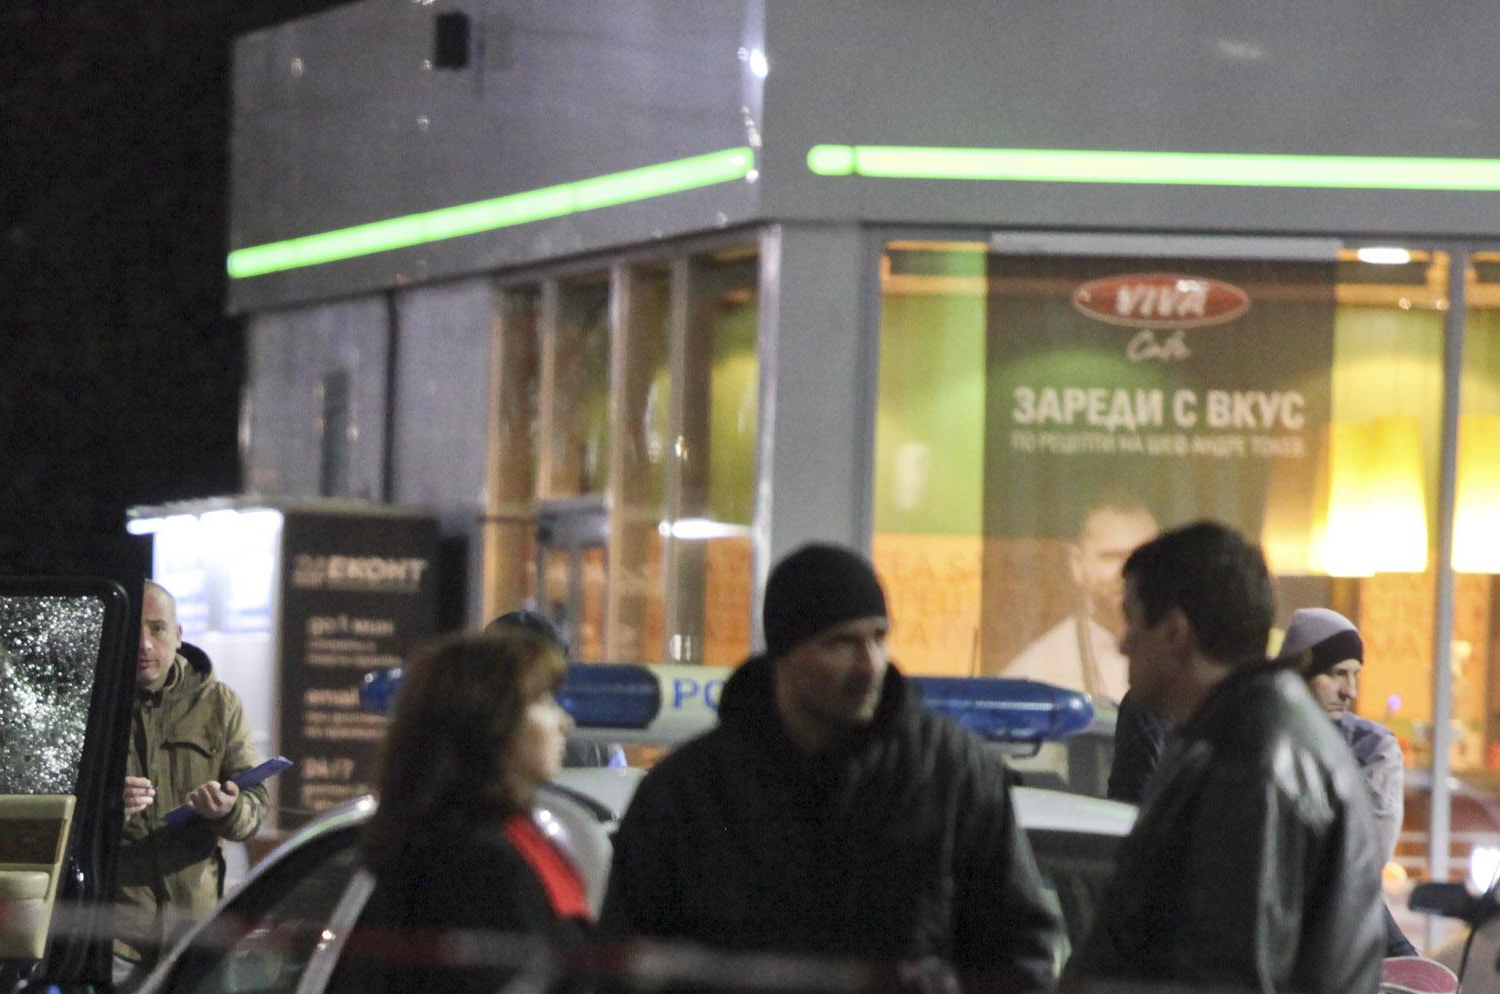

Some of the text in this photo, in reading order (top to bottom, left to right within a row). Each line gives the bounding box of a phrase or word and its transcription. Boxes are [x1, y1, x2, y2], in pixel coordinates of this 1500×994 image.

[1116, 283, 1209, 317] VIVA
[1011, 386, 1305, 431] ЗАРЕДИ С ВКУС
